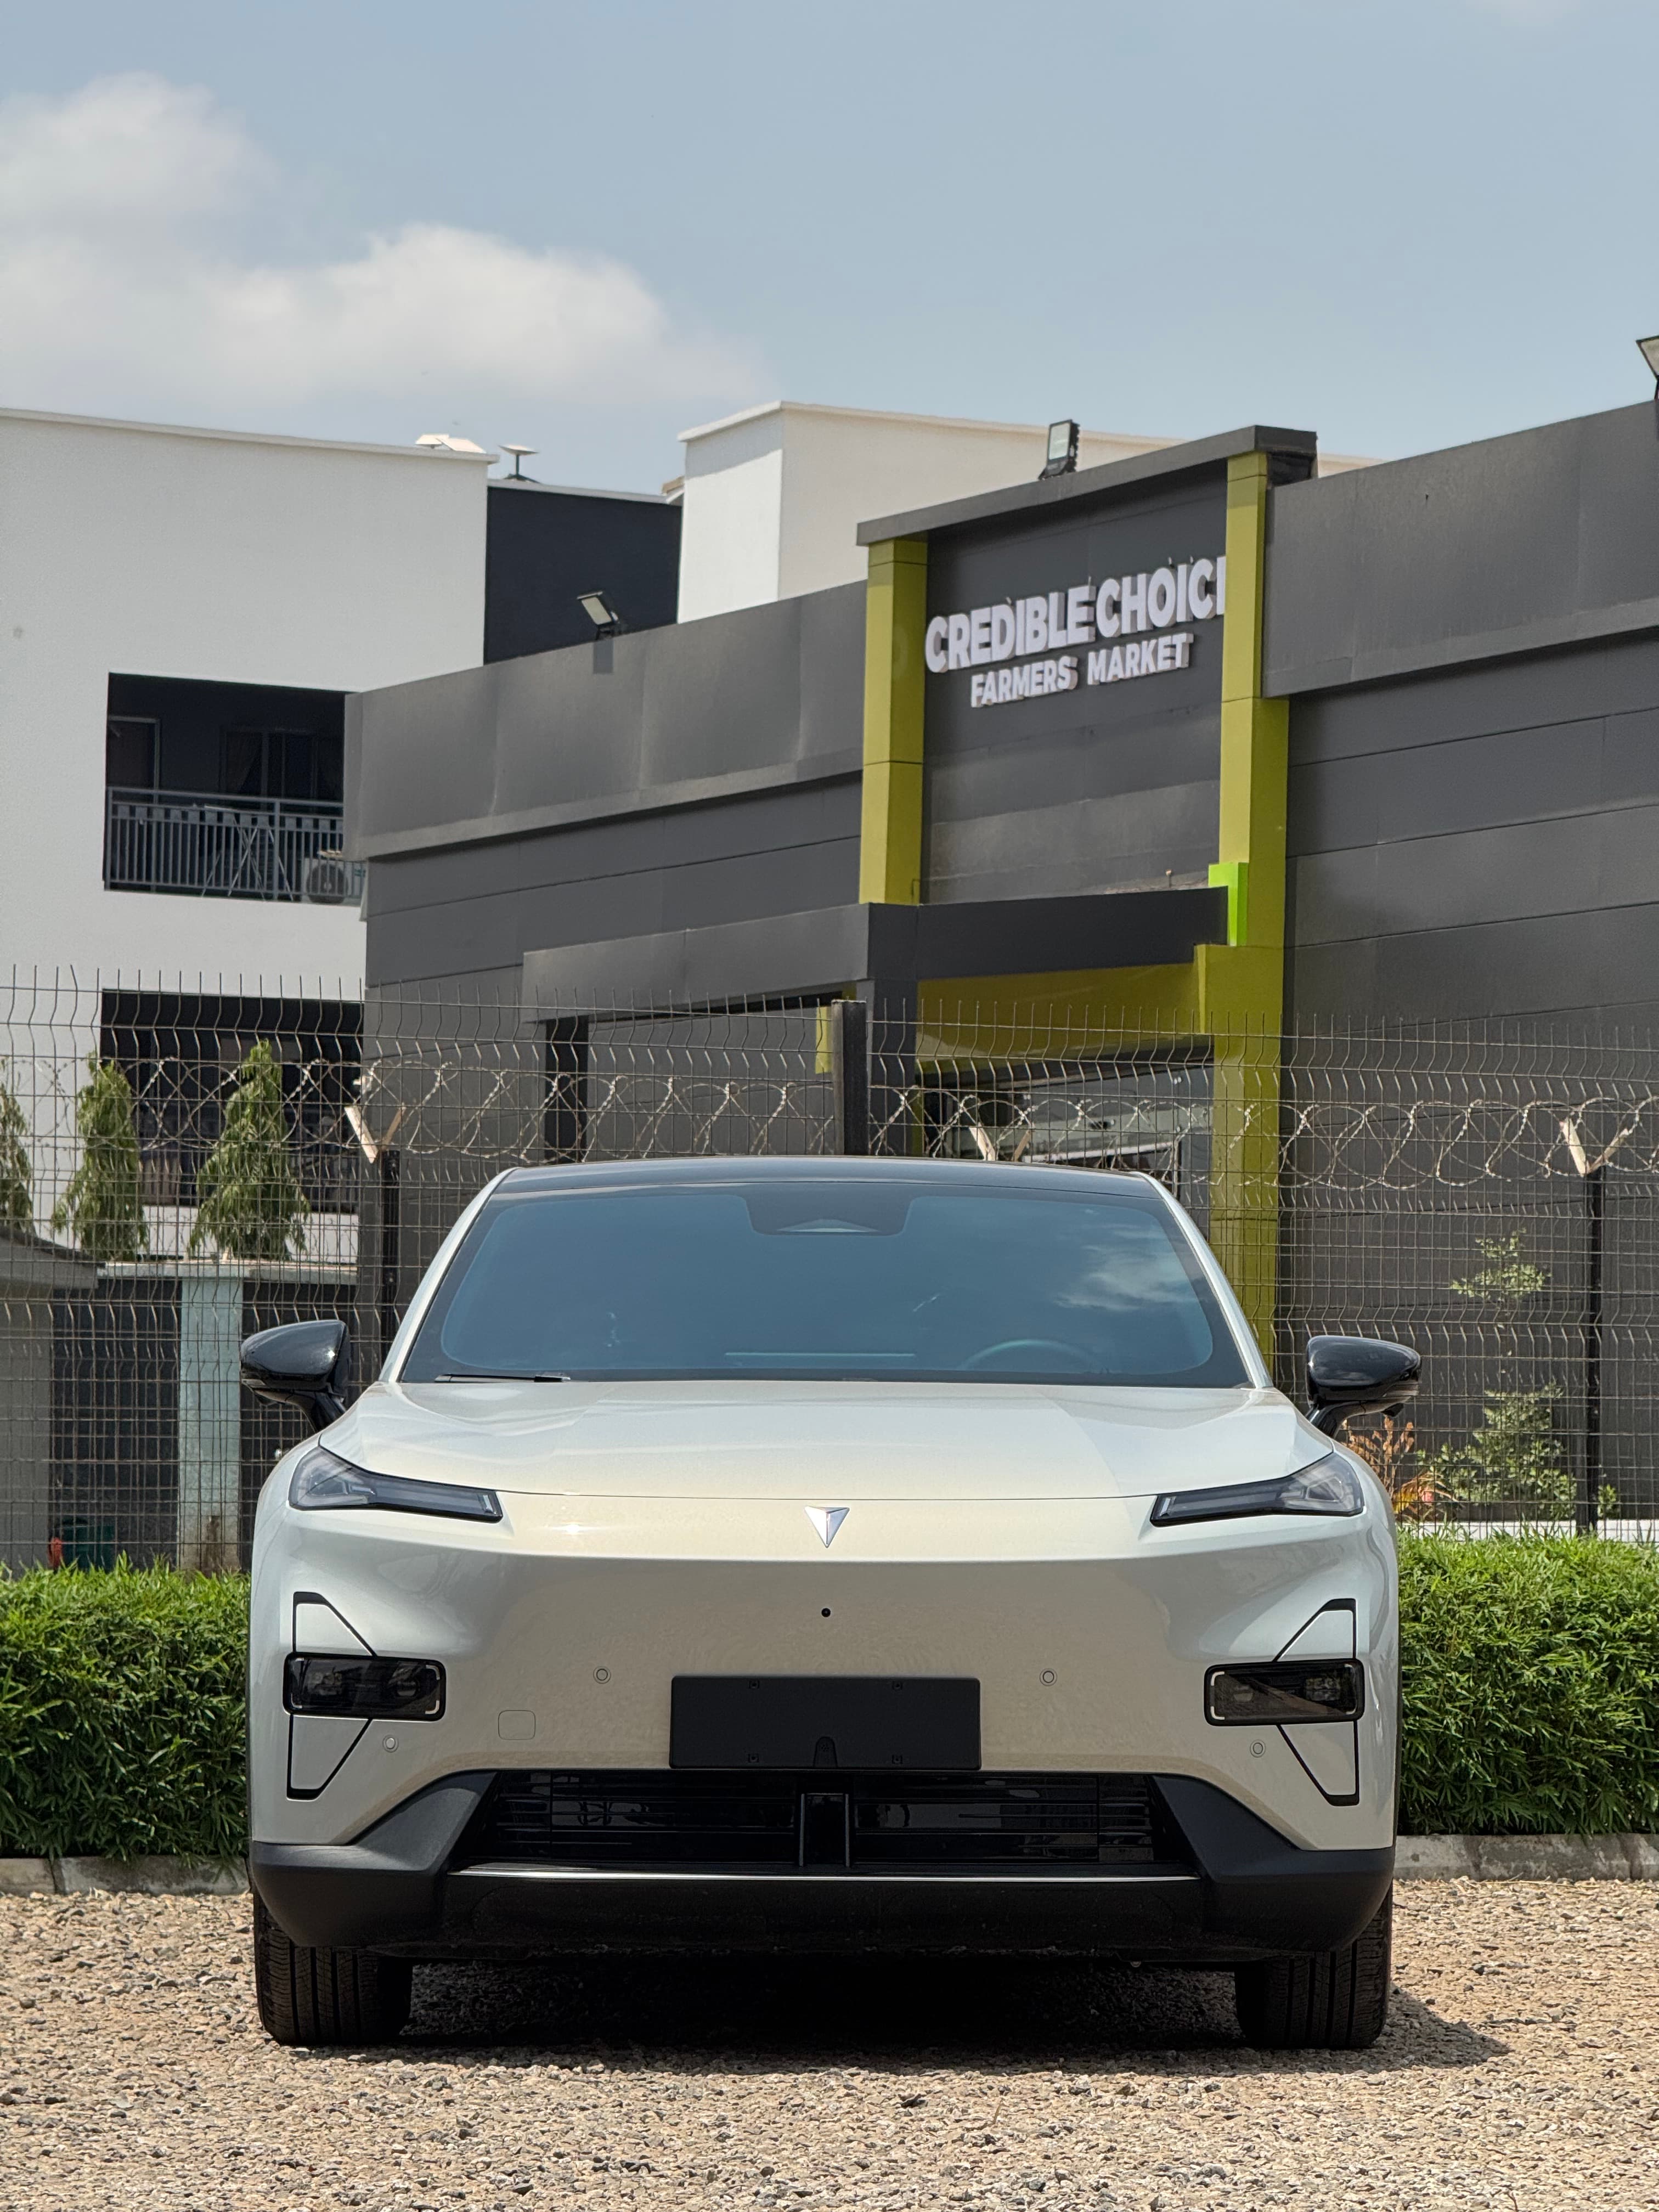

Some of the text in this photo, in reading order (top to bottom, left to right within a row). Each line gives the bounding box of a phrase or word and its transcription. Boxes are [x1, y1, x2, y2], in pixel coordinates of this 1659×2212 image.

[926, 584, 1096, 673] CREDIBLE
[971, 633, 1194, 708] FARMERS MARKET
